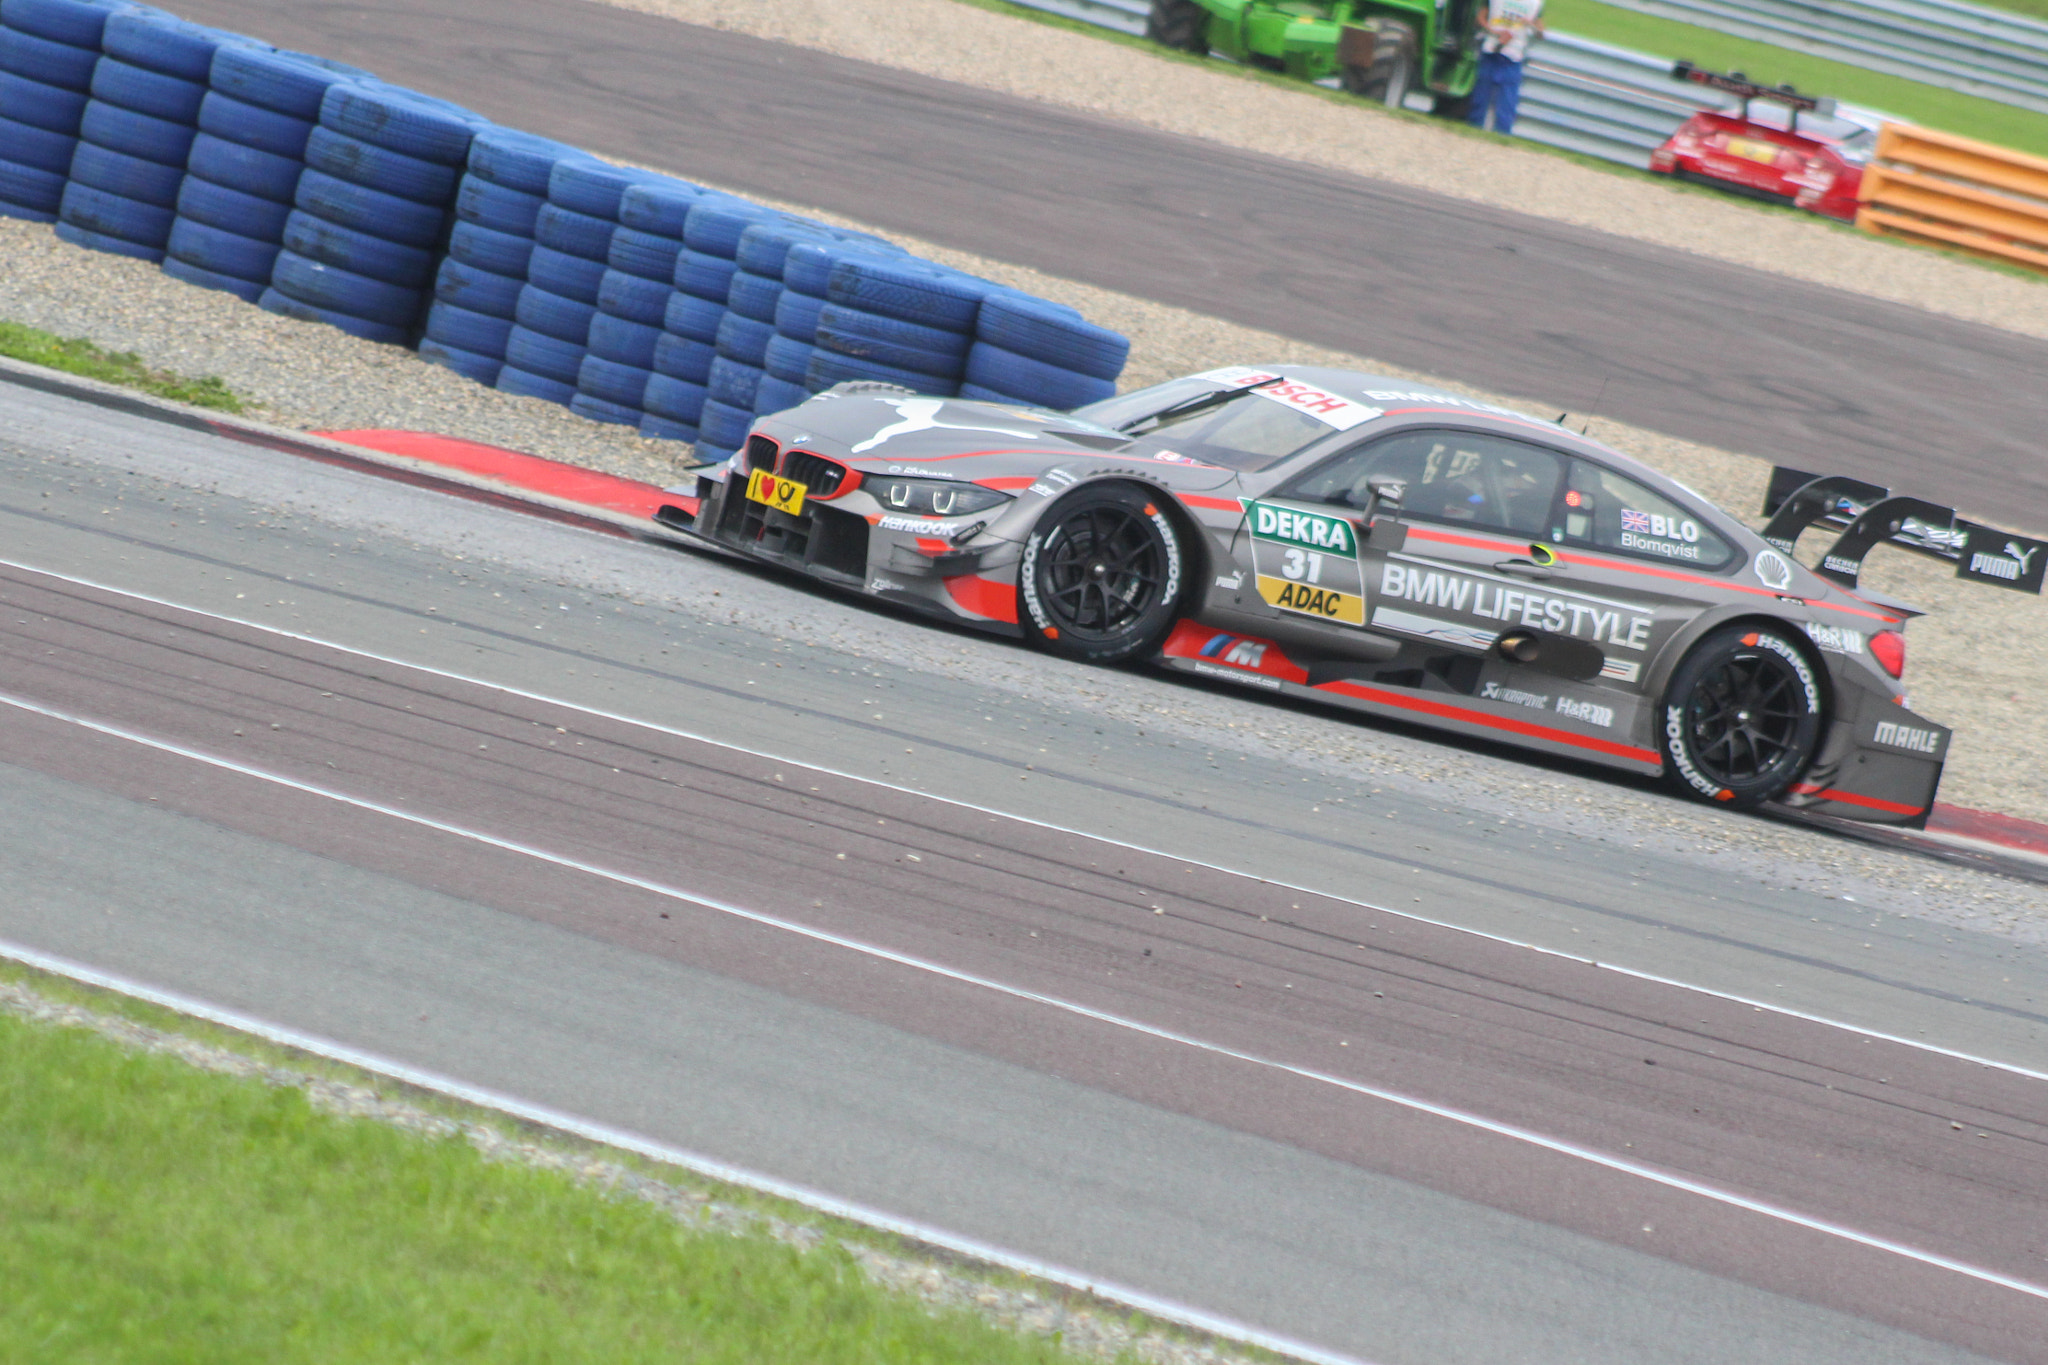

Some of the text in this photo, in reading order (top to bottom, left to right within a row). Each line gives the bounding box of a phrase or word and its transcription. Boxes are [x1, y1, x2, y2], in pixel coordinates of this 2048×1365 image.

[1257, 506, 1348, 552] DEKRA
[1650, 513, 1699, 543] BLO
[1621, 532, 1699, 559] Blomqvist
[1281, 548, 1324, 584] 31
[1969, 552, 2019, 580] PUMA
[1277, 583, 1341, 616] ADAC
[1380, 562, 1652, 651] BMW LIFESTYLE
[1194, 661, 1281, 689] bmw-motorsport.com
[1555, 696, 1592, 720] H&R
[1873, 720, 1940, 753] MAHLE
